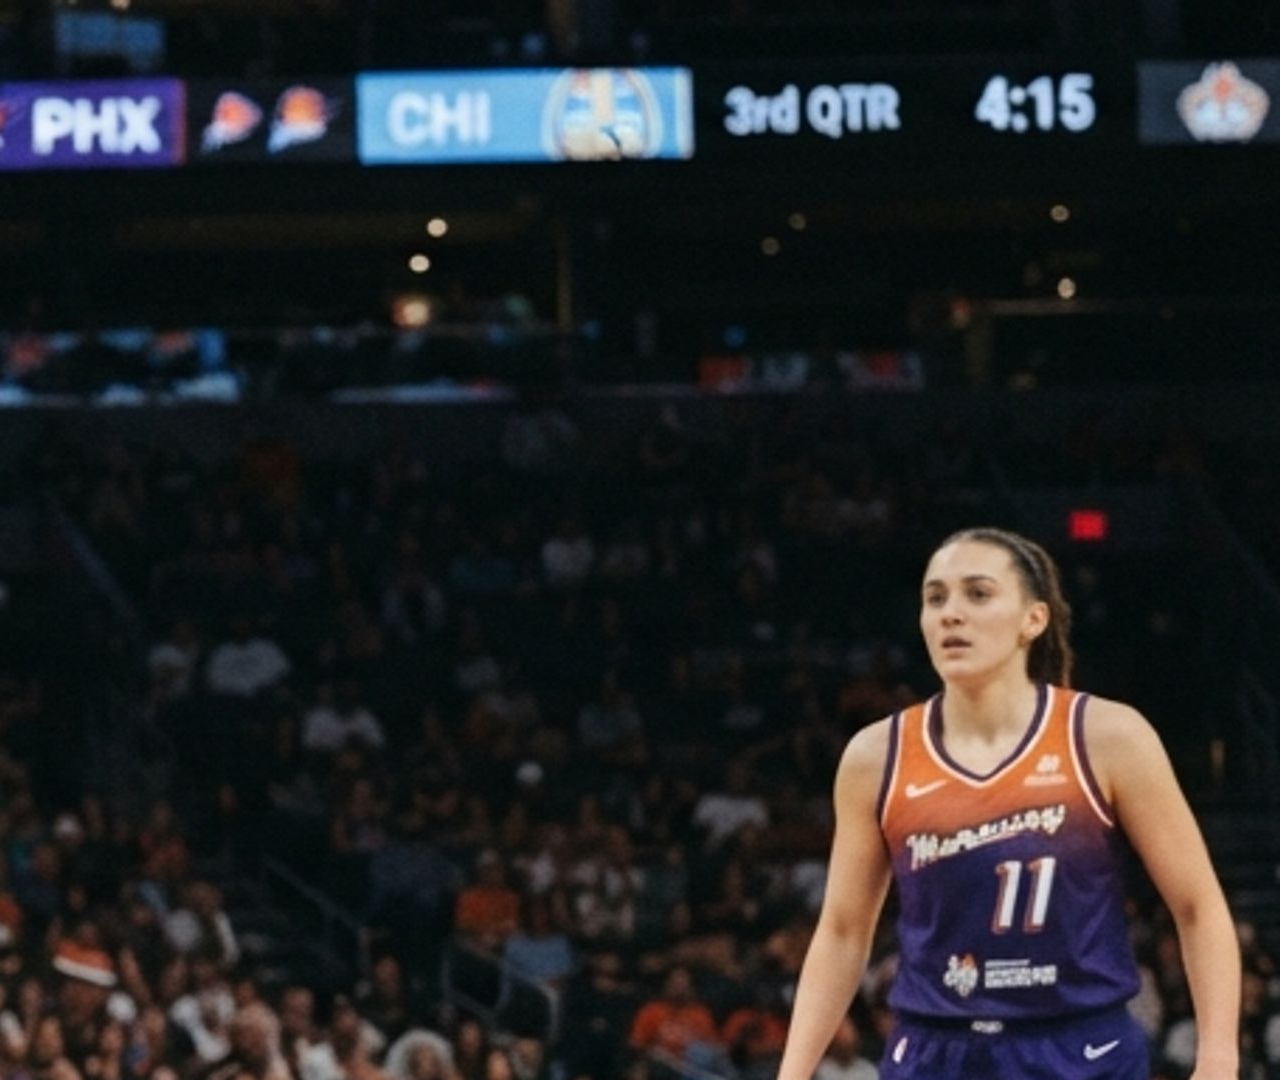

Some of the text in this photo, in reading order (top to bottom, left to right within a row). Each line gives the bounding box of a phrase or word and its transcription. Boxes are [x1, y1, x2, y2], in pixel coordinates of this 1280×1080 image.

[32, 97, 162, 155] PHX
[386, 90, 493, 146] CHI
[724, 83, 901, 138] 3rd QTR
[974, 74, 1096, 132] 4:15
[992, 856, 1056, 935] 11
